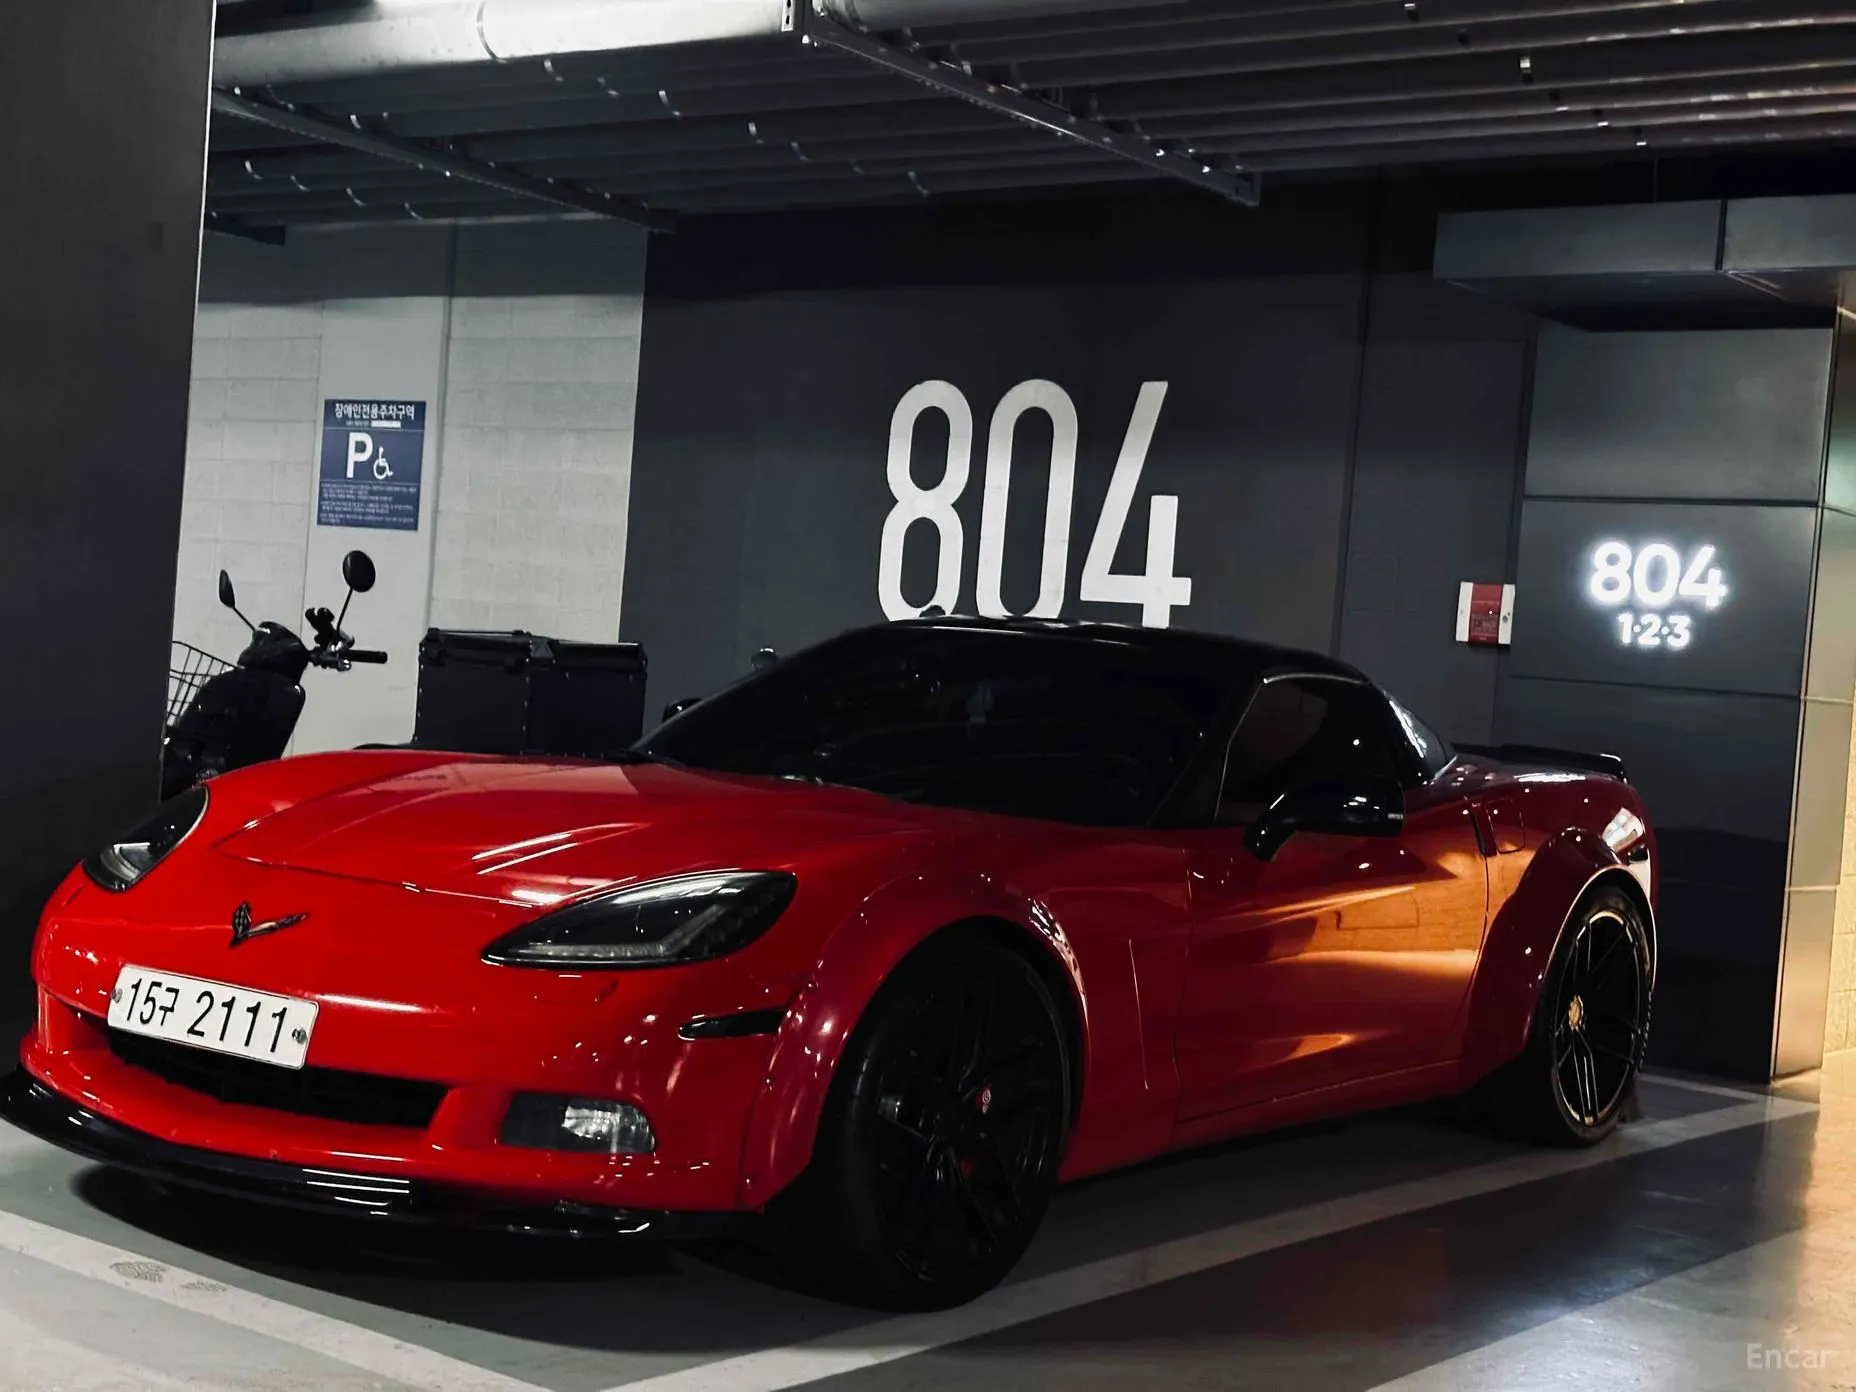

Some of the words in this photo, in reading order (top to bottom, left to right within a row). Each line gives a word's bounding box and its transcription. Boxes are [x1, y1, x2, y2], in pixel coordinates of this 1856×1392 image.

[335, 403, 415, 420] 장애인전용주차구역
[346, 431, 374, 479] P
[878, 379, 1192, 628] 804
[1589, 541, 1729, 611] 804
[126, 977, 180, 1027] 15구
[186, 990, 288, 1053] 2111
